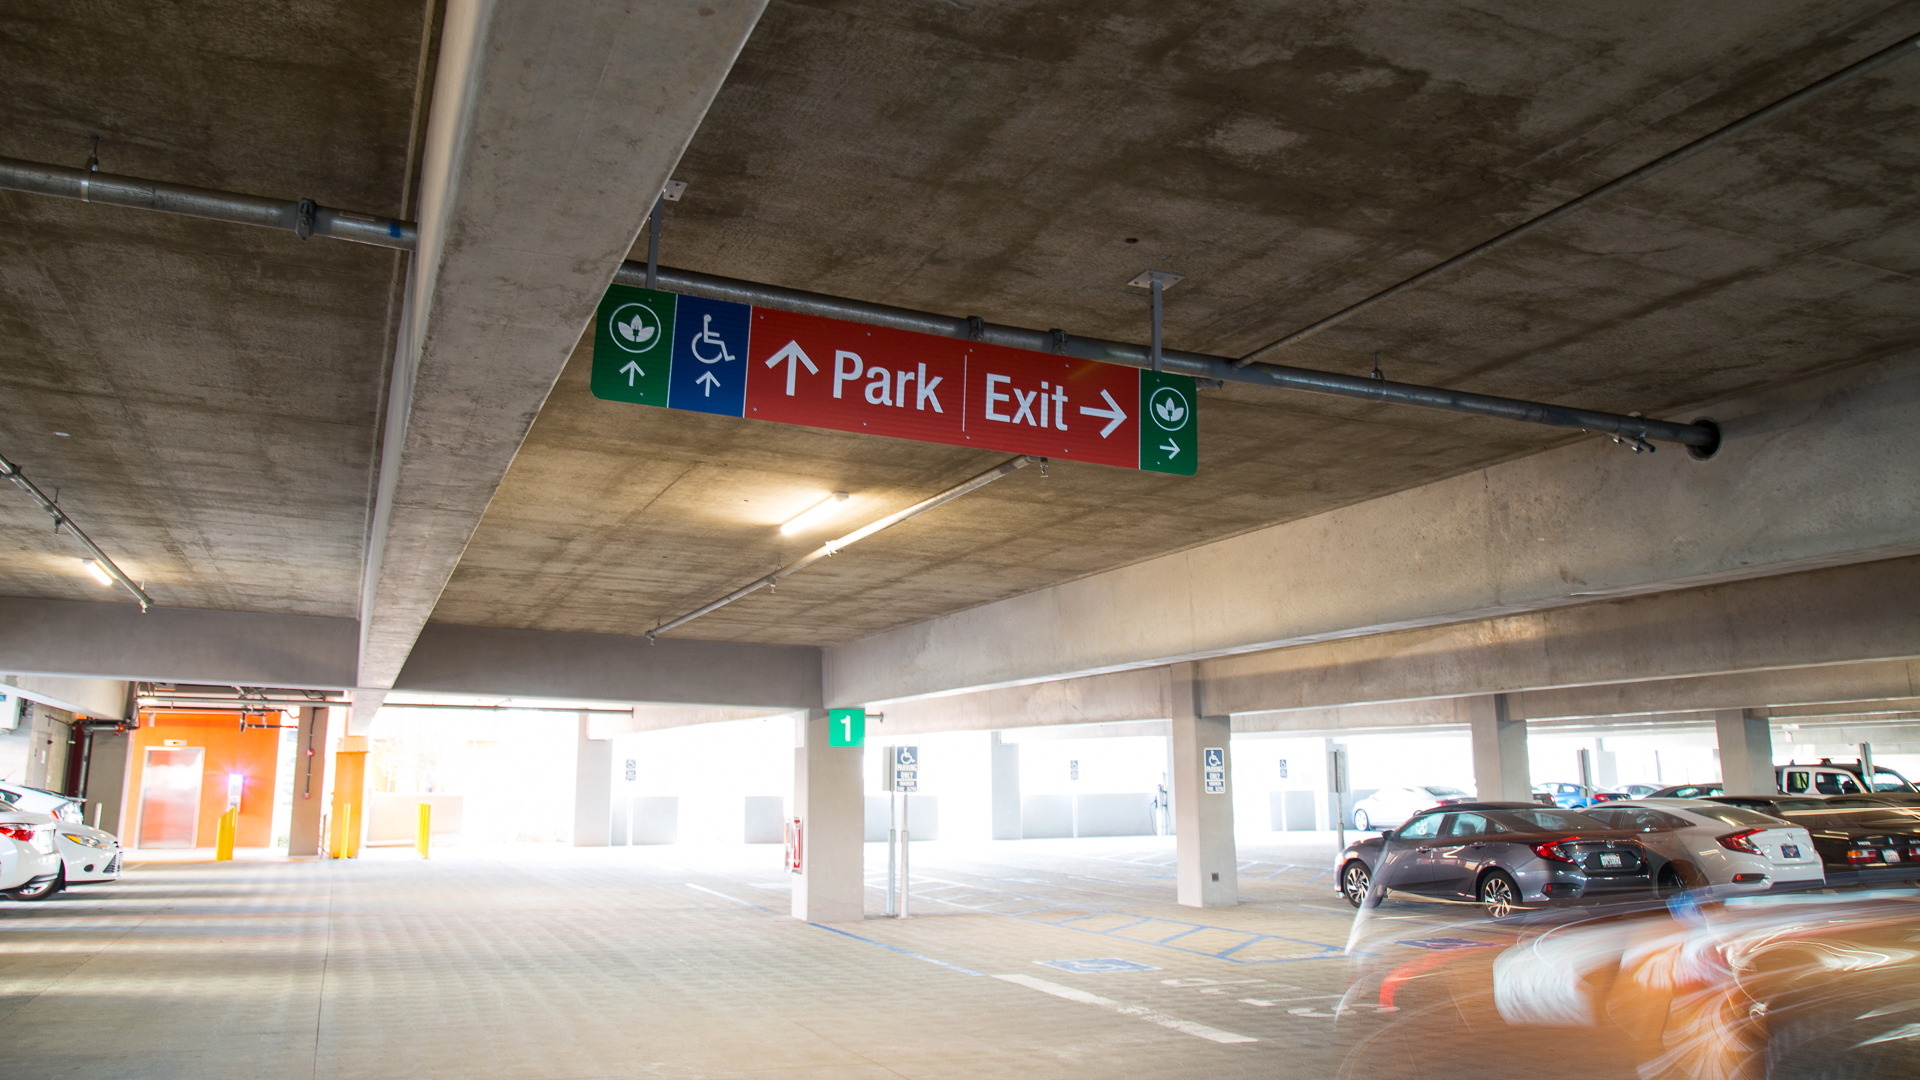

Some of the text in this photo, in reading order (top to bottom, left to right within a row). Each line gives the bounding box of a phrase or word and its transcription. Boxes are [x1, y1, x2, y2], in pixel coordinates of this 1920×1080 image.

[833, 349, 944, 414] Park
[985, 373, 1069, 431] Exit
[840, 714, 851, 742] 1
